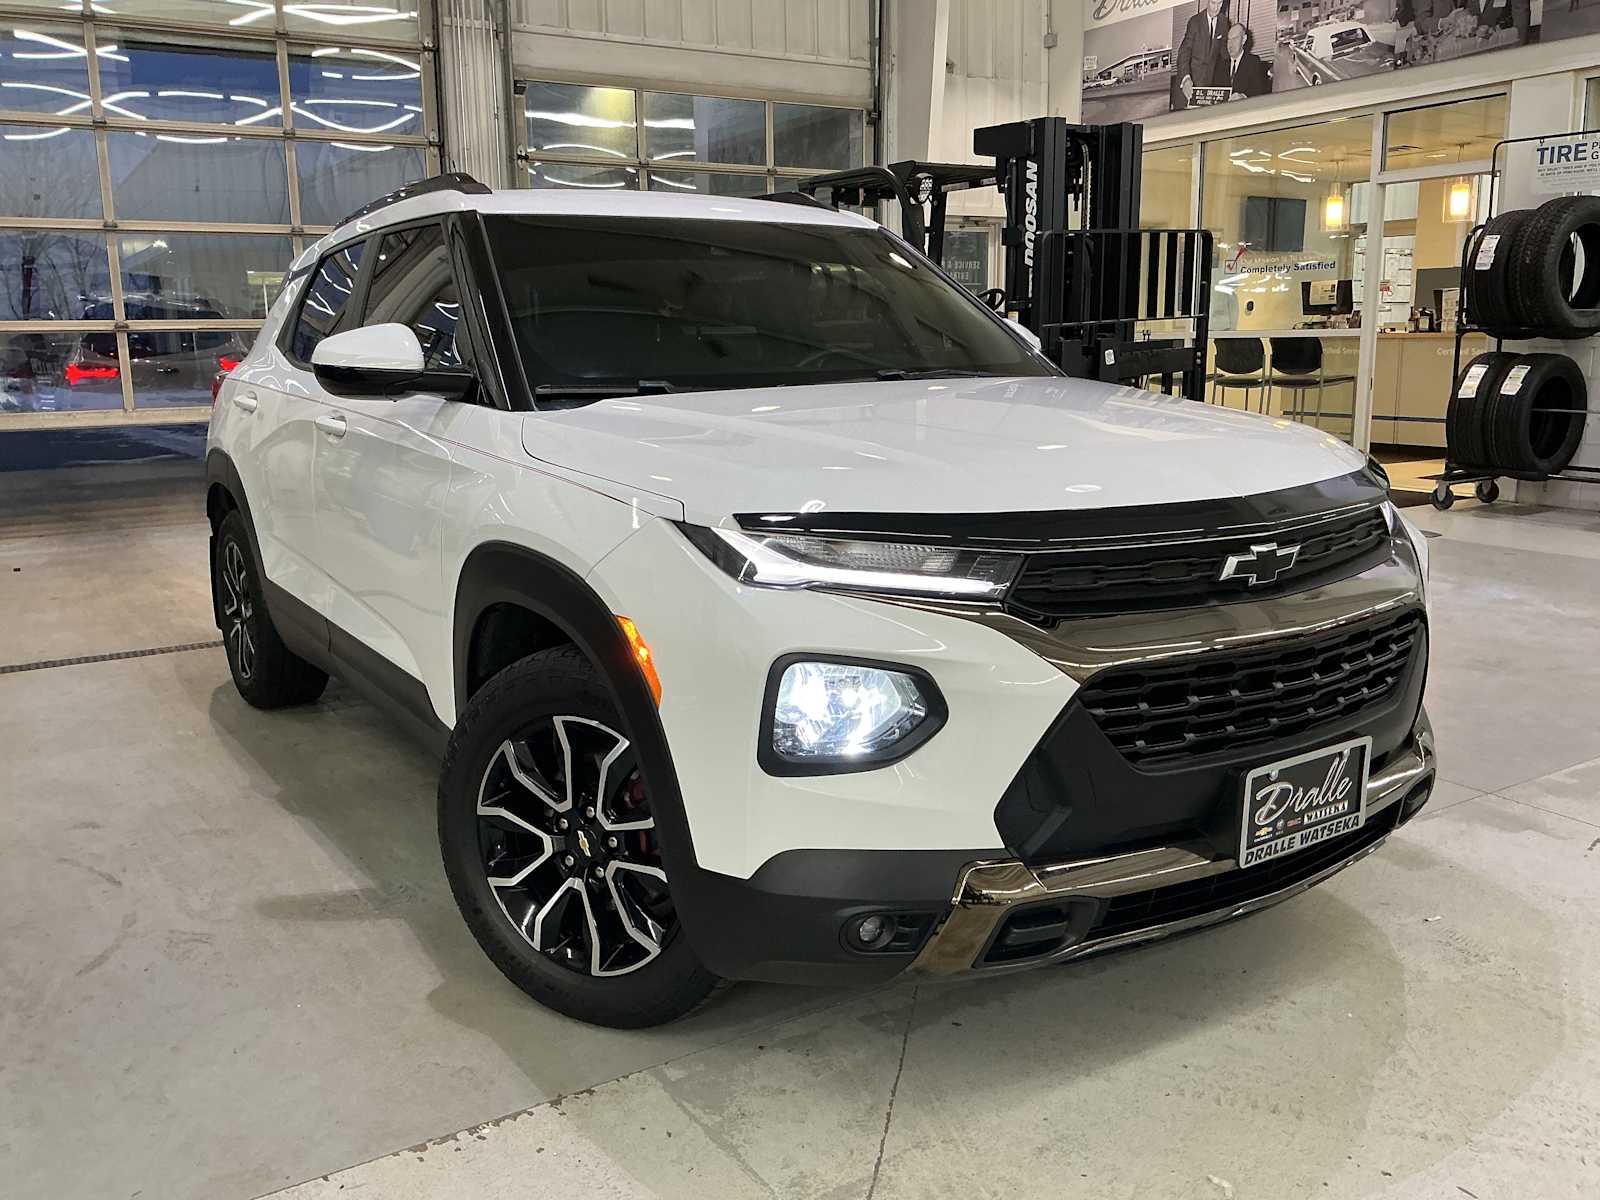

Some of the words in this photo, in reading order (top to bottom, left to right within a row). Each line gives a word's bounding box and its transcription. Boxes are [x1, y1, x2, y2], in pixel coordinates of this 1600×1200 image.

[1537, 143, 1588, 165] TIRE
[1240, 264, 1291, 274] Completely
[1293, 260, 1336, 271] Satisfied
[1255, 753, 1353, 825] Dralle
[1245, 836, 1296, 865] DRALLE
[1301, 815, 1360, 846] WATSEKA
